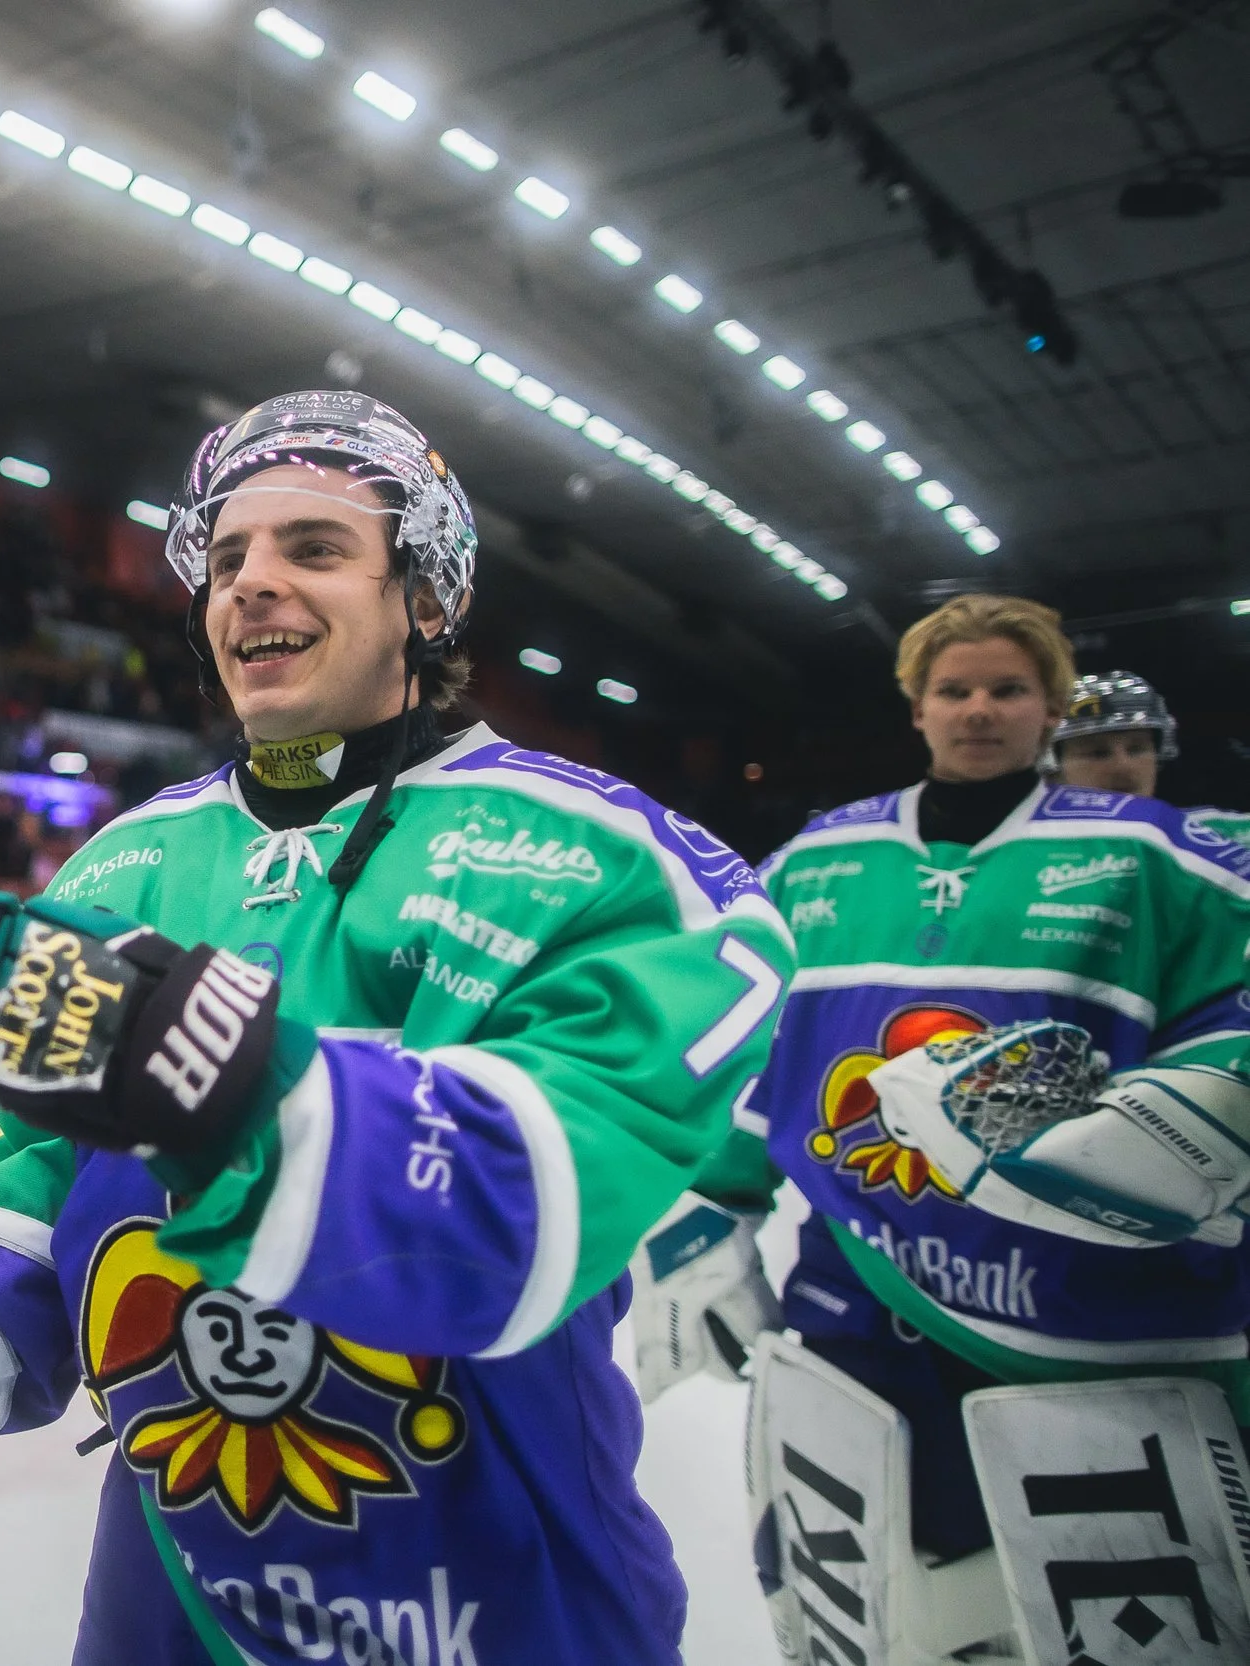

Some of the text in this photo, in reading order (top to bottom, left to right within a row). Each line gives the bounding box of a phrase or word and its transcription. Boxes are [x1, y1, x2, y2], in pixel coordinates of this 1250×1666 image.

[272, 393, 363, 408] CREATIVE
[272, 401, 363, 412] TECHNOLOGY
[313, 412, 343, 420] Events
[265, 741, 323, 763] TAKSI
[680, 932, 784, 1082] 7
[1118, 1094, 1213, 1166] WARRIOR
